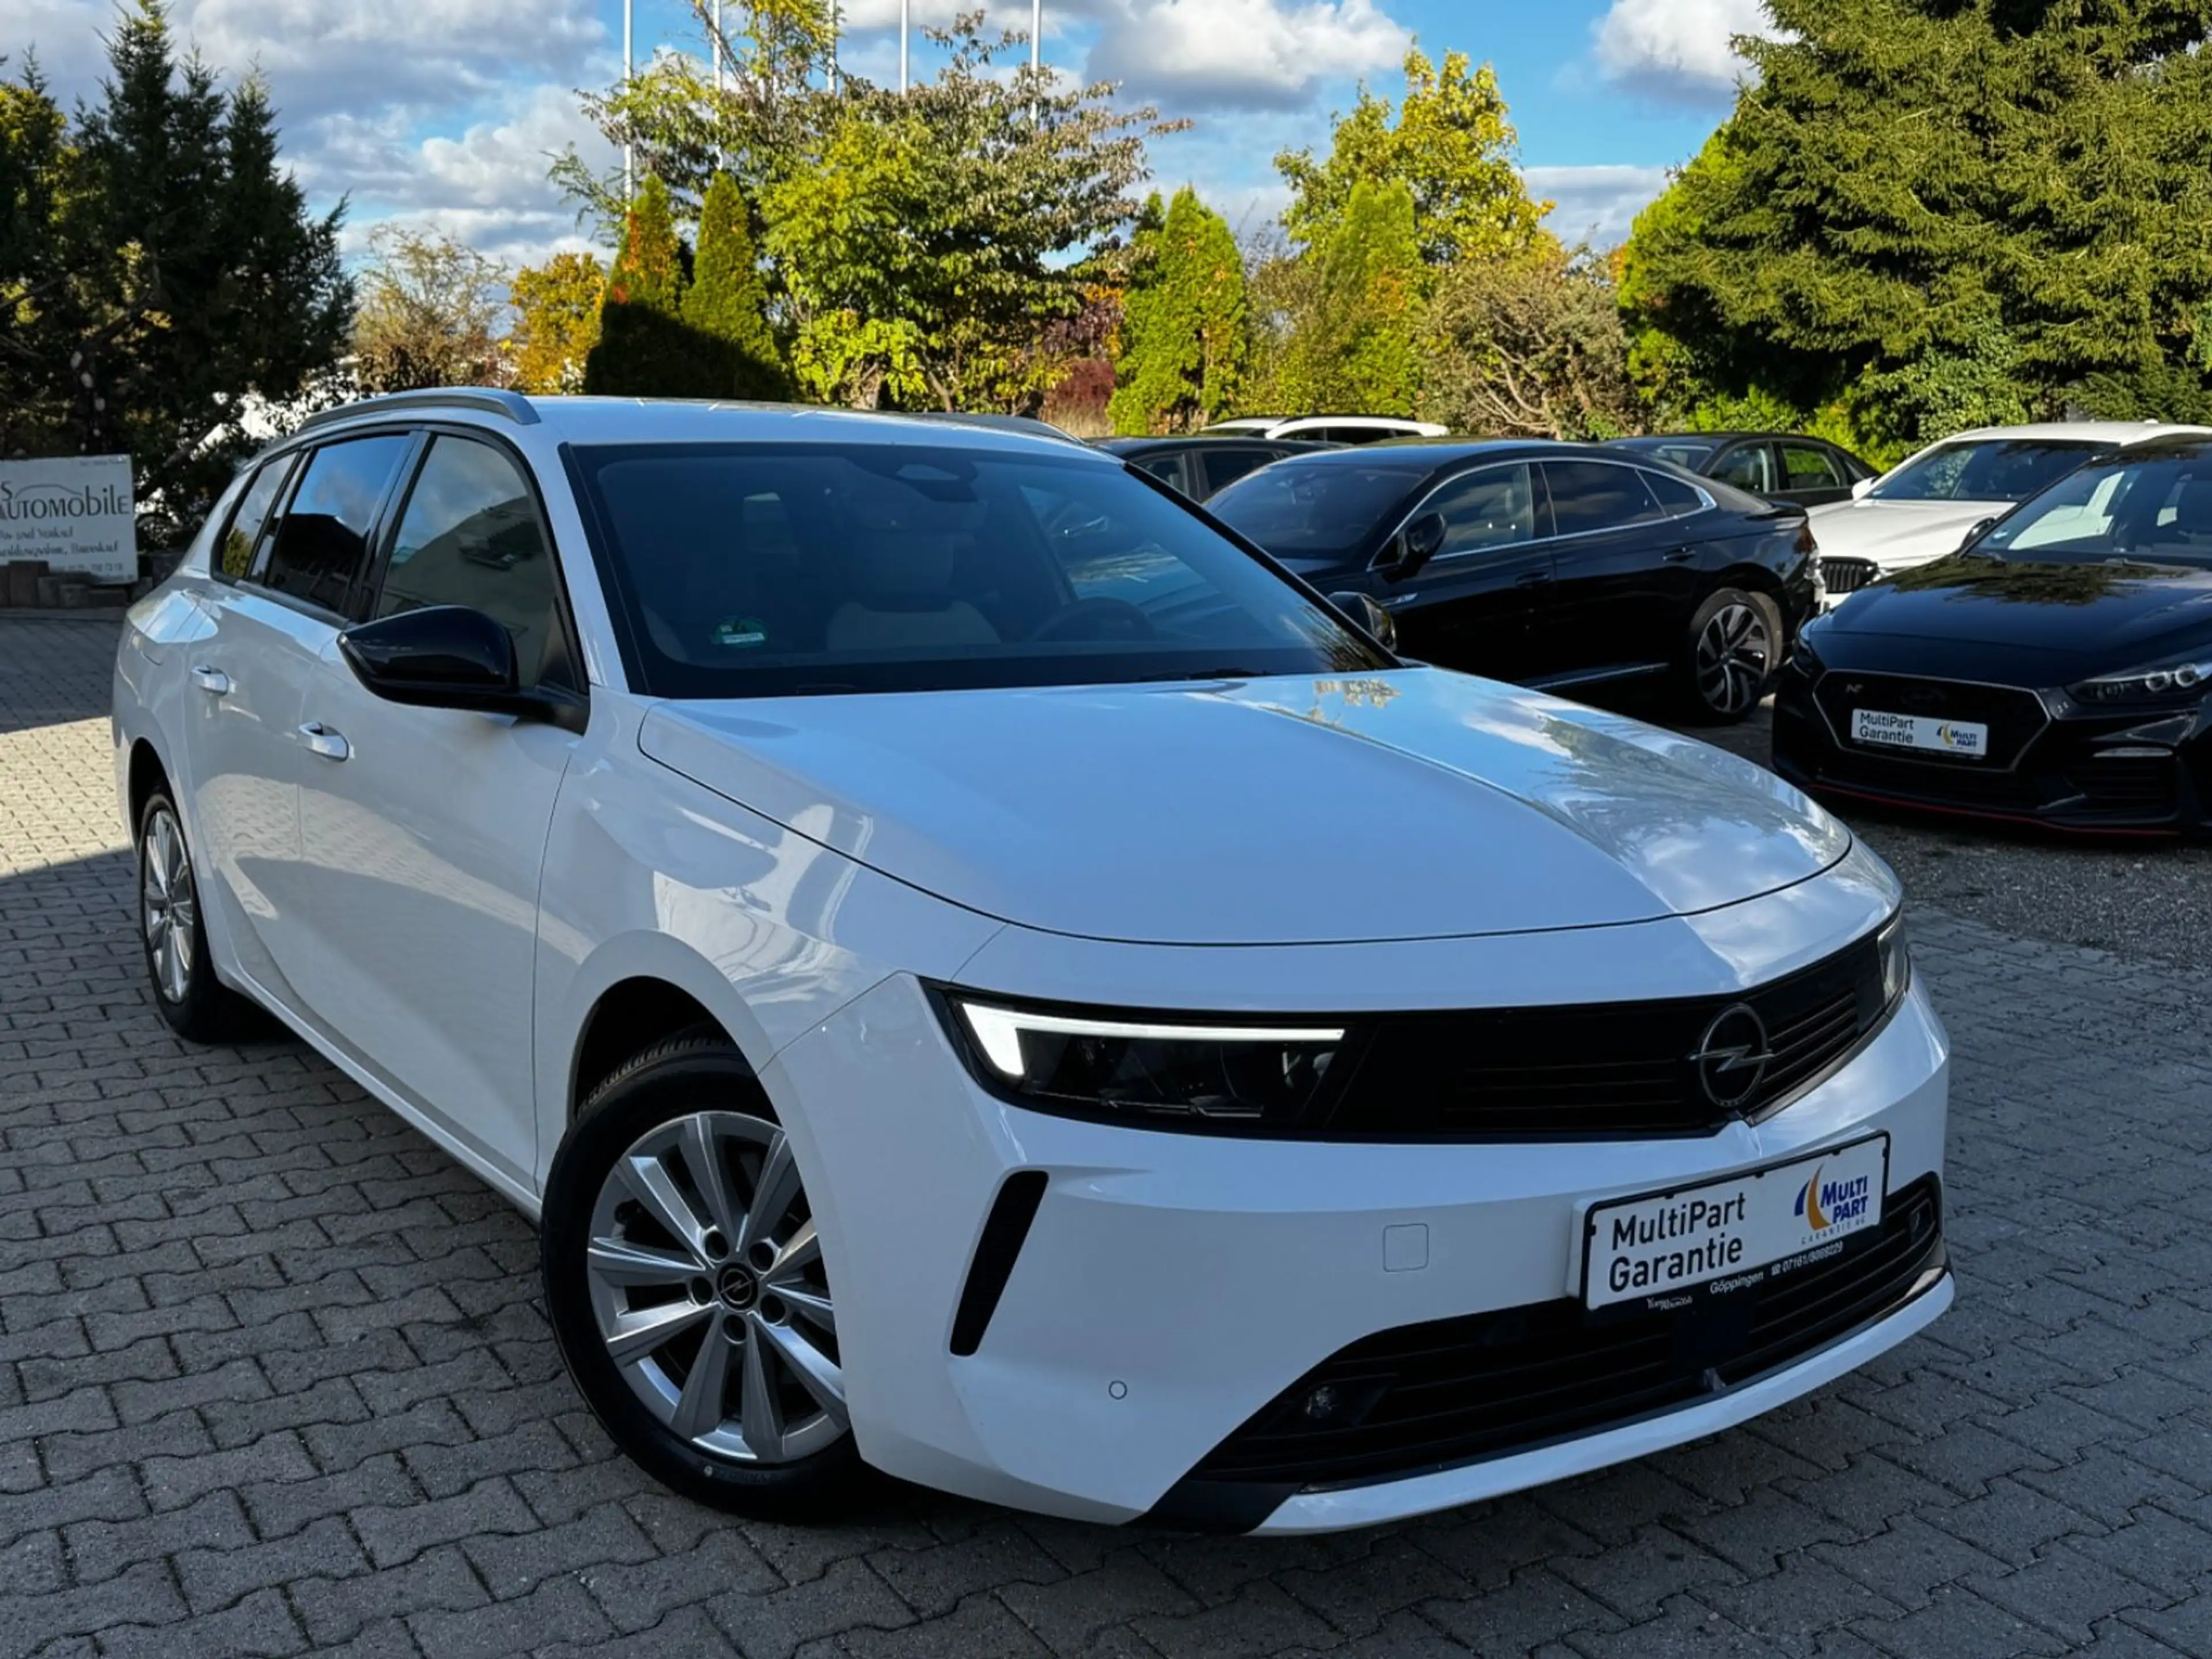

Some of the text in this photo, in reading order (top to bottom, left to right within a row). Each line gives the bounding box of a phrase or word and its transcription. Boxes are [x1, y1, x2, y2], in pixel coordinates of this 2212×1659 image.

[1860, 712, 1914, 730] MultiPart
[1859, 725, 1914, 744] Garantie
[1820, 1175, 1868, 1208] MULTI
[1612, 1192, 1746, 1251] MultiPart
[1832, 1195, 1869, 1224] PART
[1801, 1222, 1851, 1245] GARANTIE
[1608, 1233, 1743, 1292] Garantie
[1709, 1271, 1764, 1295] Göppingen
